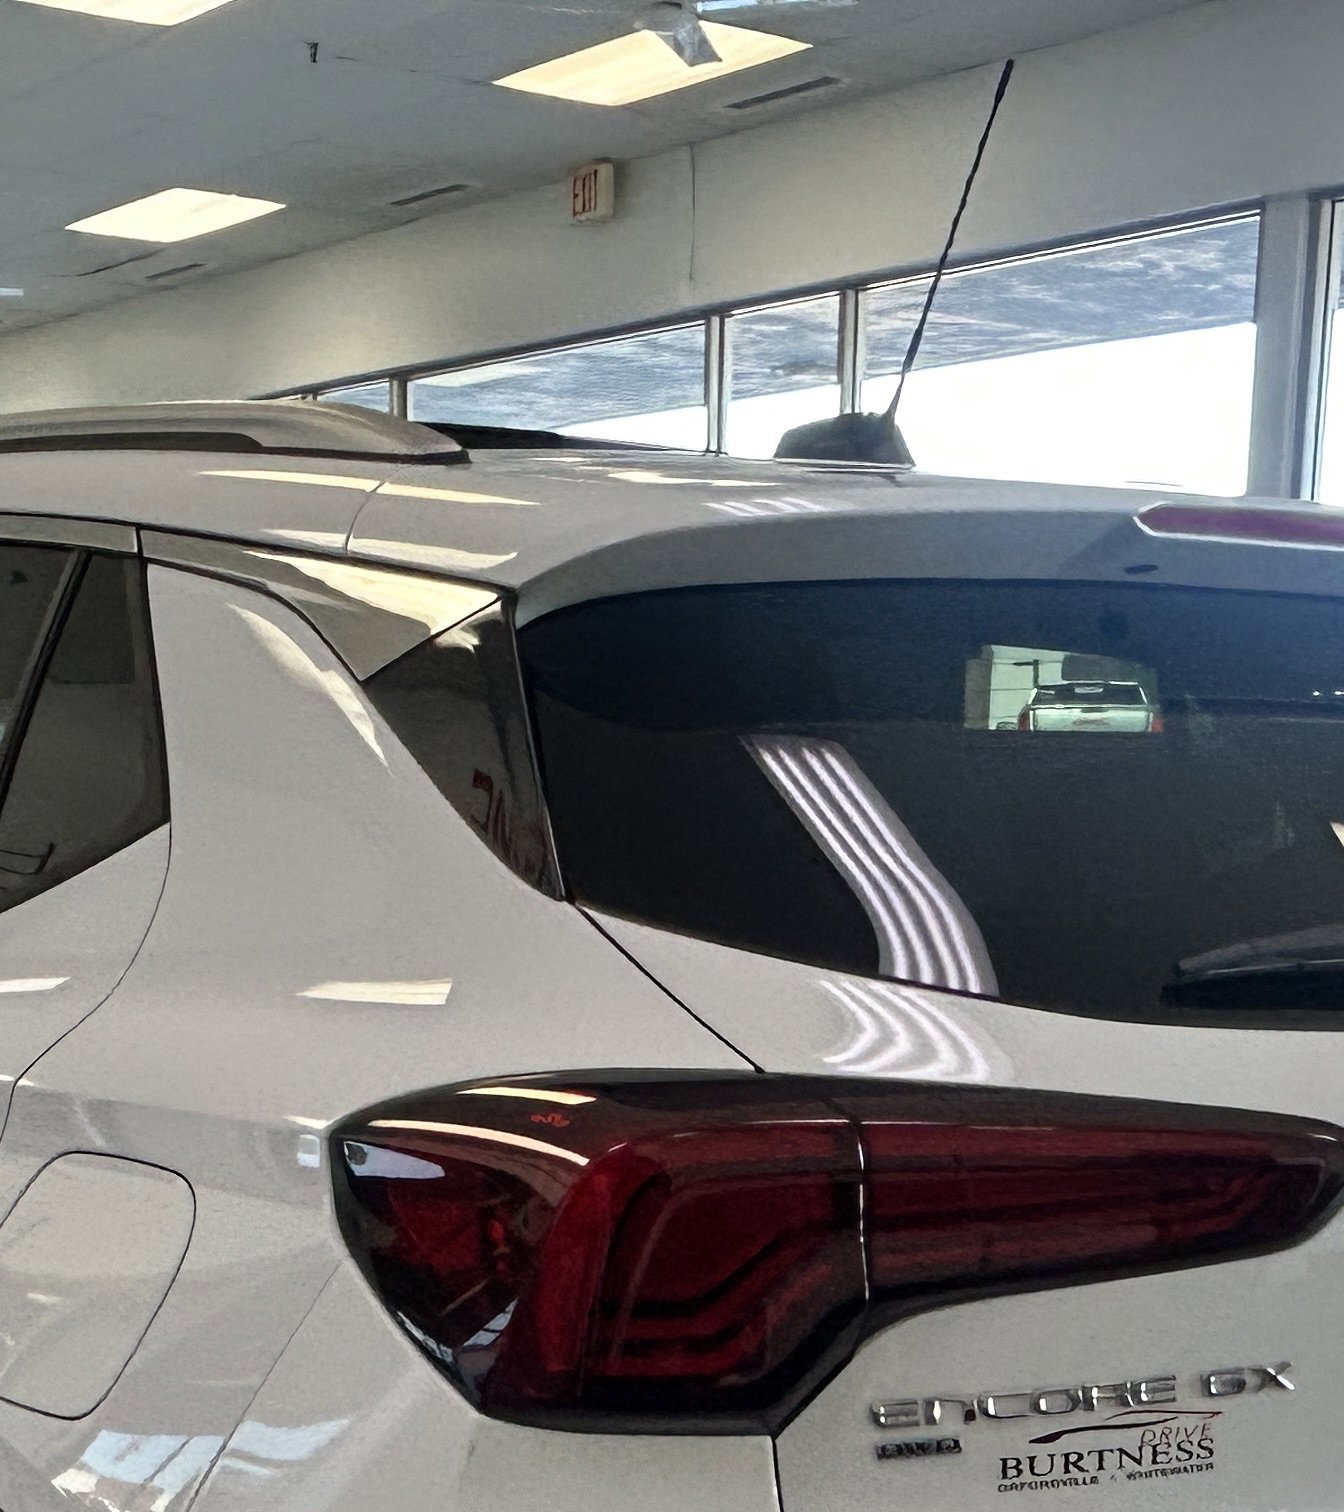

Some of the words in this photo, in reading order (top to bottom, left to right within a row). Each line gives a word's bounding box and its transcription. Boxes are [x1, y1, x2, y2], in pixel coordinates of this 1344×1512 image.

[869, 1375, 1177, 1427] ENCORE
[1200, 1361, 1295, 1398] GX
[1139, 1422, 1213, 1448] DRIVE
[999, 1438, 1215, 1480] BURTNESS
